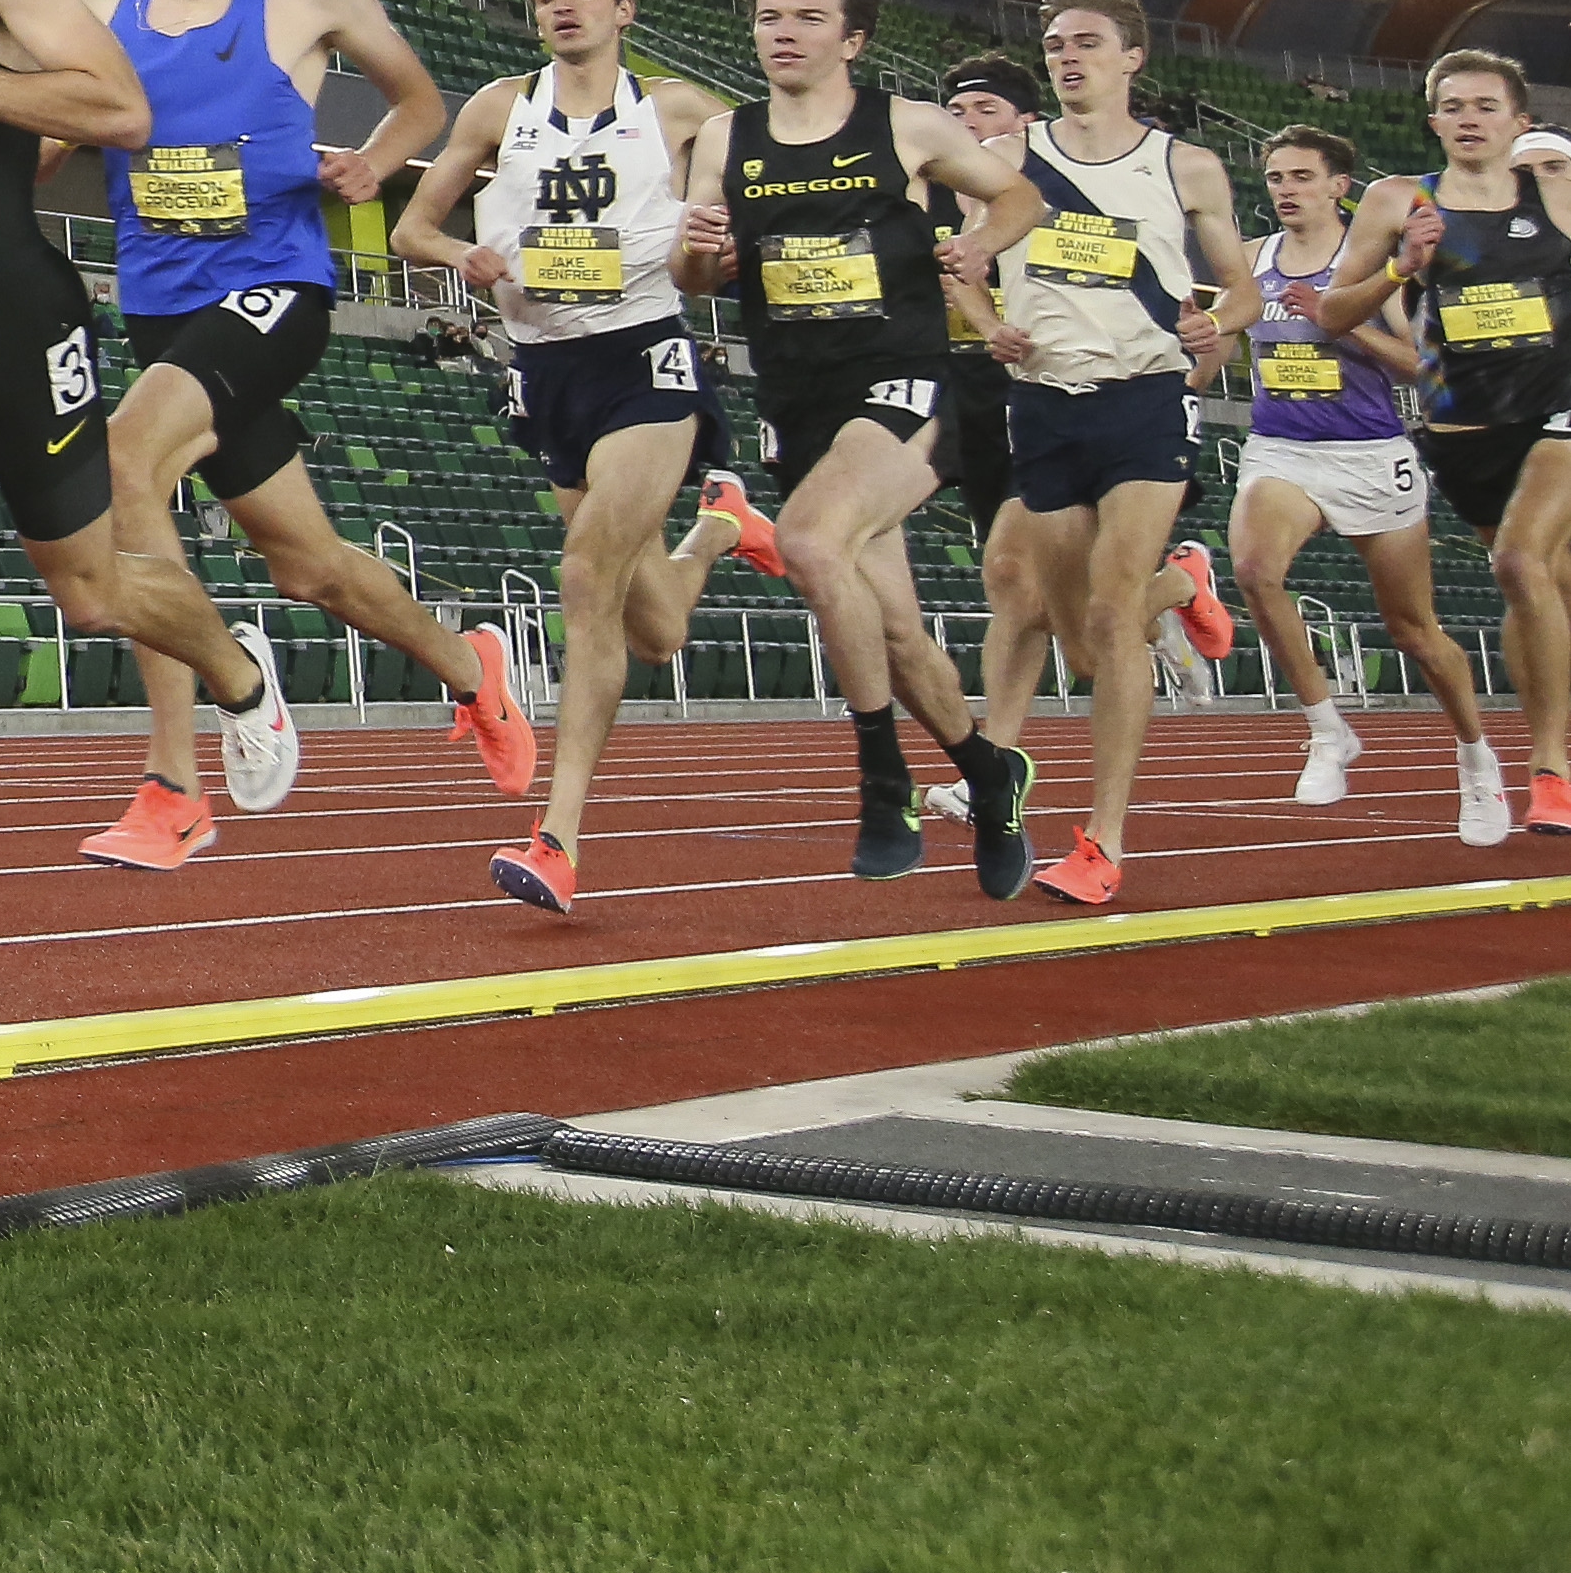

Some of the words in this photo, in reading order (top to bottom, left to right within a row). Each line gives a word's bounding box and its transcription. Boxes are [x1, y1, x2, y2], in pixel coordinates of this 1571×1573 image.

[147, 180, 224, 194] CAMERON
[743, 175, 877, 199] OREGON
[1056, 237, 1109, 254] DANIEL
[551, 256, 586, 269] JAKE
[1061, 250, 1099, 264] WINN
[538, 267, 603, 281] RENFREE
[797, 266, 837, 281] JACK
[784, 278, 854, 294] YEARIAN
[1472, 307, 1514, 321] TRIPP
[1476, 316, 1517, 331] HURT
[657, 342, 687, 386] 4
[59, 342, 87, 405] 3
[1393, 457, 1413, 492] 5
